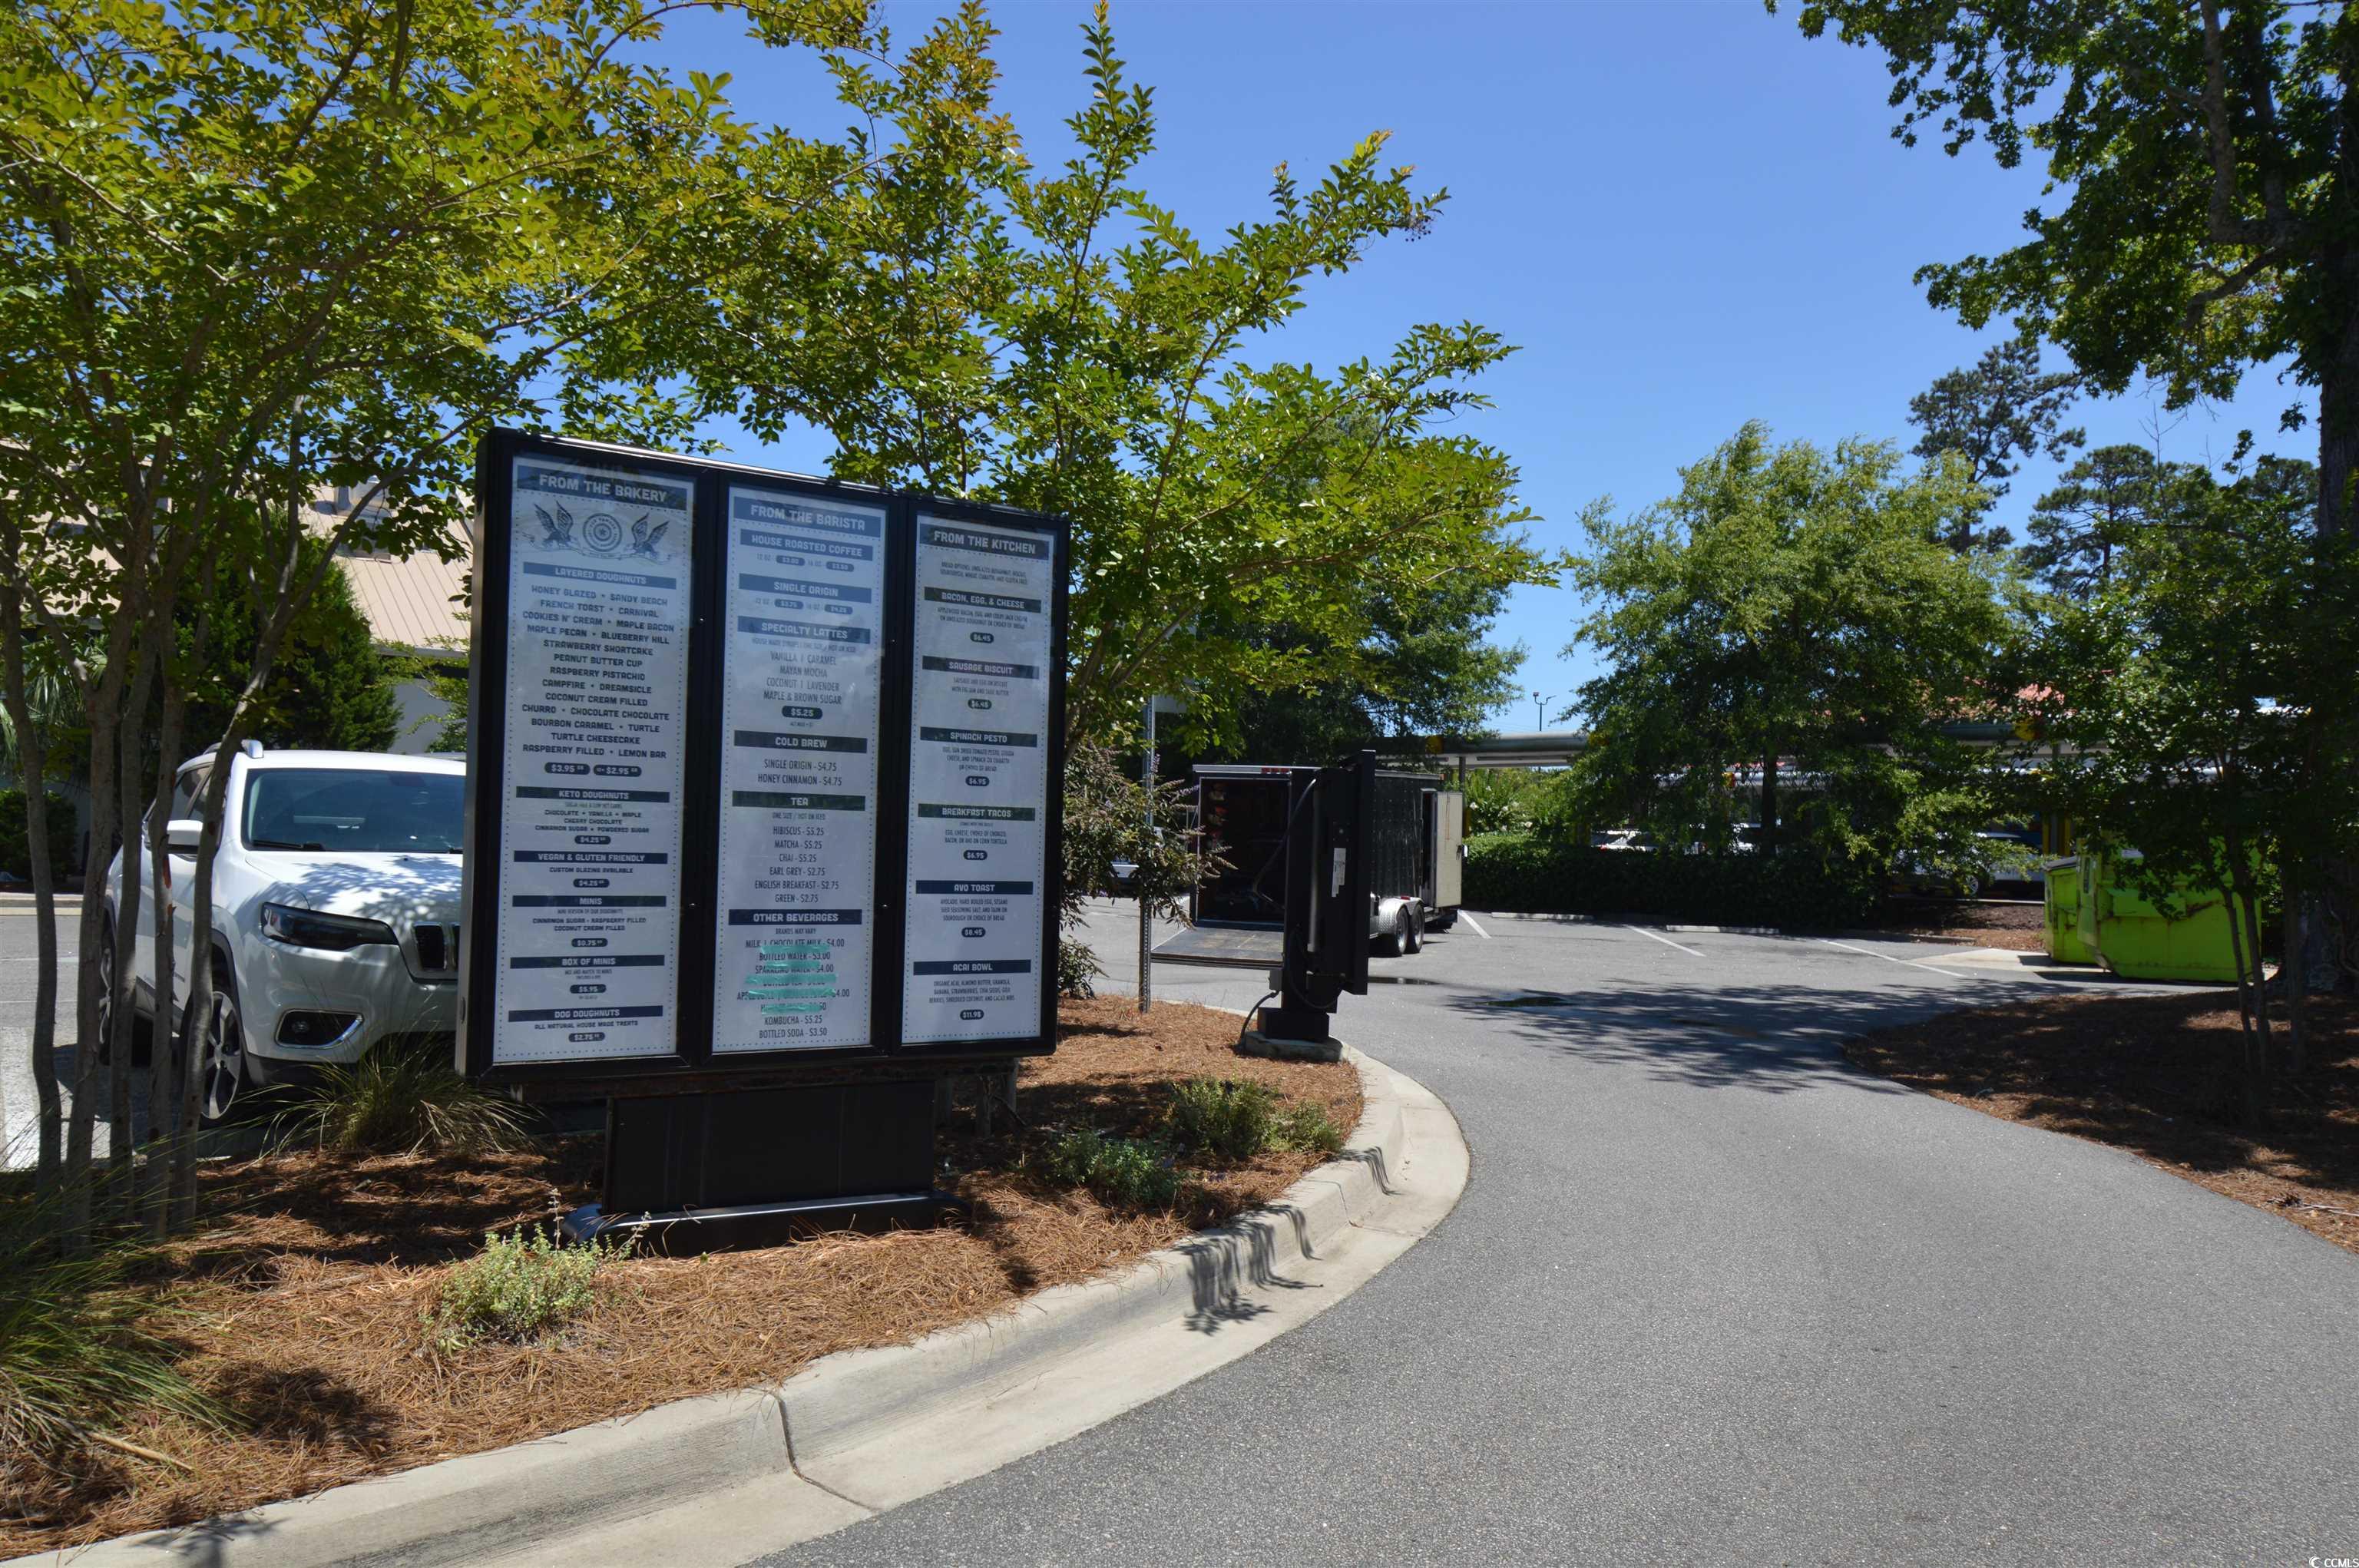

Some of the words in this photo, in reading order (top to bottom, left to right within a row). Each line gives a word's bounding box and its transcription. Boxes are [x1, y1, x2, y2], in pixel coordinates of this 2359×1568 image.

[539, 474, 578, 490] FROM
[583, 480, 610, 494] THE
[615, 485, 667, 501] BAKERY
[750, 504, 785, 519] FROM
[789, 509, 812, 523] THE
[816, 514, 865, 531] BARISTA
[752, 534, 782, 546] HOUSE
[784, 538, 826, 552] ROASTED
[829, 544, 862, 557] COFFEE
[934, 530, 964, 544] FROM
[968, 535, 988, 547] THE
[991, 538, 1035, 554] KITCHEN
[554, 567, 594, 578] LAYERED
[597, 571, 647, 584] DOUGHNUTS
[531, 585, 561, 595] HONEY
[563, 588, 597, 599] GLAZED
[609, 593, 637, 603] SANDY
[640, 596, 667, 606] BEACH
[773, 581, 806, 593] SINGLE
[809, 585, 839, 597] ORIGIN
[941, 592, 968, 602] BACON,
[997, 599, 1024, 609] CHEESE
[540, 599, 574, 610] FRENCH
[577, 603, 604, 612] TOAST
[617, 607, 659, 617] CARNIVAL
[522, 610, 559, 621] COOKIES
[572, 615, 602, 625] CREAM
[616, 619, 645, 629] MAPLE
[647, 622, 674, 631] BACON
[526, 624, 557, 634] MAPLE
[559, 627, 587, 637] PECAN
[601, 631, 649, 642] BLUEBERRY
[651, 636, 670, 644] HILL
[761, 622, 809, 635] SPECIALTY
[812, 627, 848, 639] LATTES
[543, 639, 601, 651] STRAWBERRY
[604, 644, 653, 655] SHORTCAKE
[553, 653, 587, 663] PEANUT
[590, 657, 624, 666] BUTTER
[626, 659, 643, 667] CUP
[769, 650, 798, 662] VANILLA
[806, 654, 835, 666] CARAMEL
[550, 667, 599, 677] RASPBERRY
[602, 670, 645, 680] PISTACHIO
[779, 665, 802, 675] MAYAN
[803, 667, 828, 677] MOCHA
[949, 661, 983, 671] SAUSAGE
[984, 665, 1012, 674] BISCUIT
[541, 679, 585, 689] CAMPFIRE
[599, 683, 652, 693] DREAMSICLE
[766, 676, 797, 688] COCONUT
[806, 680, 839, 692] LAVENDER
[545, 693, 585, 702] COCONUT
[587, 695, 617, 704] CREAM
[619, 697, 648, 706] FILLED
[763, 690, 785, 700] MAPLE
[786, 692, 792, 701] &
[793, 692, 819, 703] BROWN
[819, 694, 842, 705] SUGAR
[521, 704, 557, 713] CHURRO
[570, 707, 619, 717] CHOCOLATE
[621, 710, 670, 720] CHOCOLATE
[790, 708, 813, 716] $5.25
[531, 718, 571, 727] BOURBON
[574, 720, 614, 730] CARAMEL
[627, 723, 660, 733] TURTLE
[551, 733, 584, 741] TURTLE
[586, 734, 640, 744] CHEESECAKE
[775, 737, 798, 746] COLD
[801, 739, 827, 748] BREW
[522, 744, 573, 754] RASPBERRY
[575, 746, 604, 756] FILLED
[617, 749, 647, 757] LEMON
[649, 750, 667, 759] BAR
[763, 759, 787, 769] SINGLE
[788, 760, 812, 770] ORIGIN
[757, 772, 780, 783] HONEY
[782, 774, 817, 785] CINNAMON
[583, 791, 629, 799] DOUGHNUTS
[790, 797, 808, 806] TEA
[773, 825, 801, 835] HIBISCUS
[774, 839, 799, 849] MATCHA
[778, 853, 792, 862] CHAI
[769, 866, 785, 875] EARL
[786, 867, 802, 875] GREY
[754, 880, 780, 888] ENGLISH
[782, 880, 816, 889] BREAKFAST
[774, 894, 795, 902] GREEN
[572, 1009, 620, 1017] DOUGHNUTS
[764, 1016, 799, 1025] KOMBUCHA
[759, 1029, 785, 1038] BOTTLED
[787, 1028, 804, 1037] SODA
